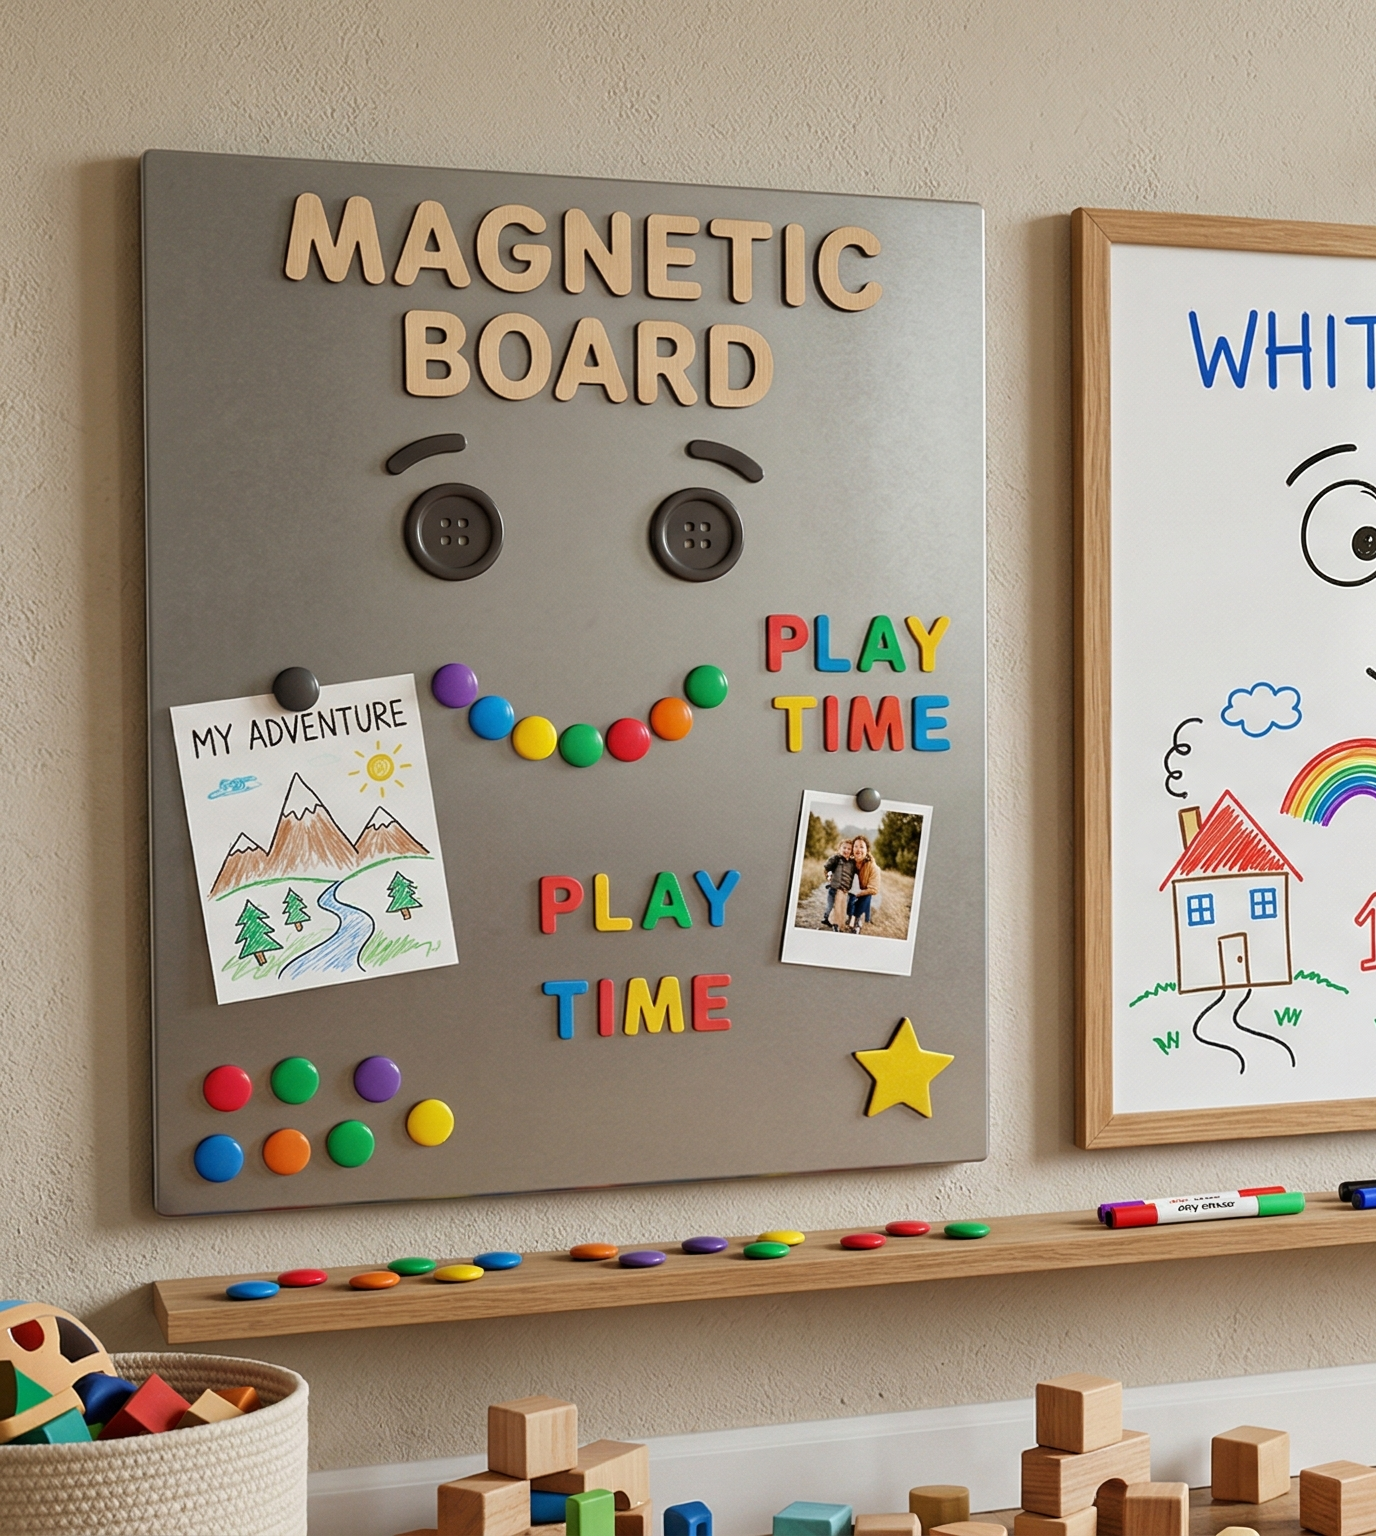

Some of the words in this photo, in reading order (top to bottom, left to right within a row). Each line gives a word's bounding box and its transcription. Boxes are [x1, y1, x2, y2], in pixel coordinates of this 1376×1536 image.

[284, 192, 882, 311] MAGNETIC
[403, 310, 774, 408] BOARD
[765, 613, 951, 673] PLAY
[191, 723, 232, 759] MY
[249, 698, 407, 750] ADVENTURE
[771, 694, 951, 753] TIME
[539, 869, 740, 934] PLAY
[541, 973, 732, 1040] TIME
